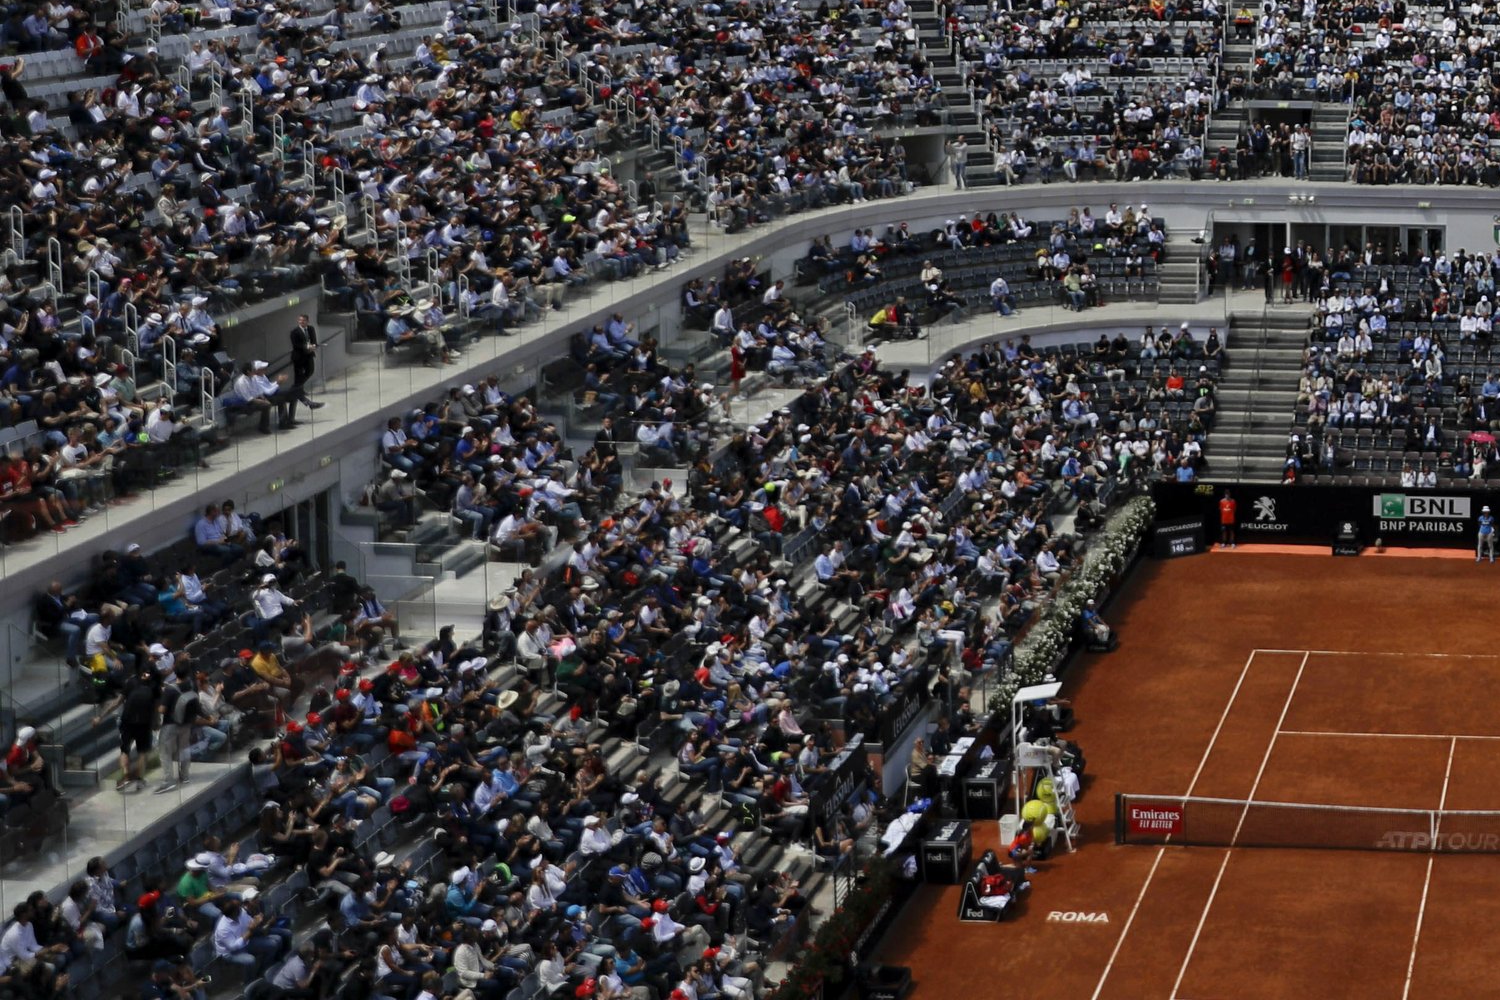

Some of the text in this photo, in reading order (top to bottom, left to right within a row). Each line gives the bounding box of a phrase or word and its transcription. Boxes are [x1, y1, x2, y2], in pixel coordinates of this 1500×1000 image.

[1410, 498, 1463, 516] BNL
[1240, 522, 1289, 530] PEUGEOT
[1379, 520, 1464, 532] BNP PARIBAS
[1132, 808, 1180, 820] Emirates
[1139, 819, 1173, 829] FLY BETTER
[1437, 832, 1500, 850] TOUR
[1046, 911, 1110, 923] ROMA
